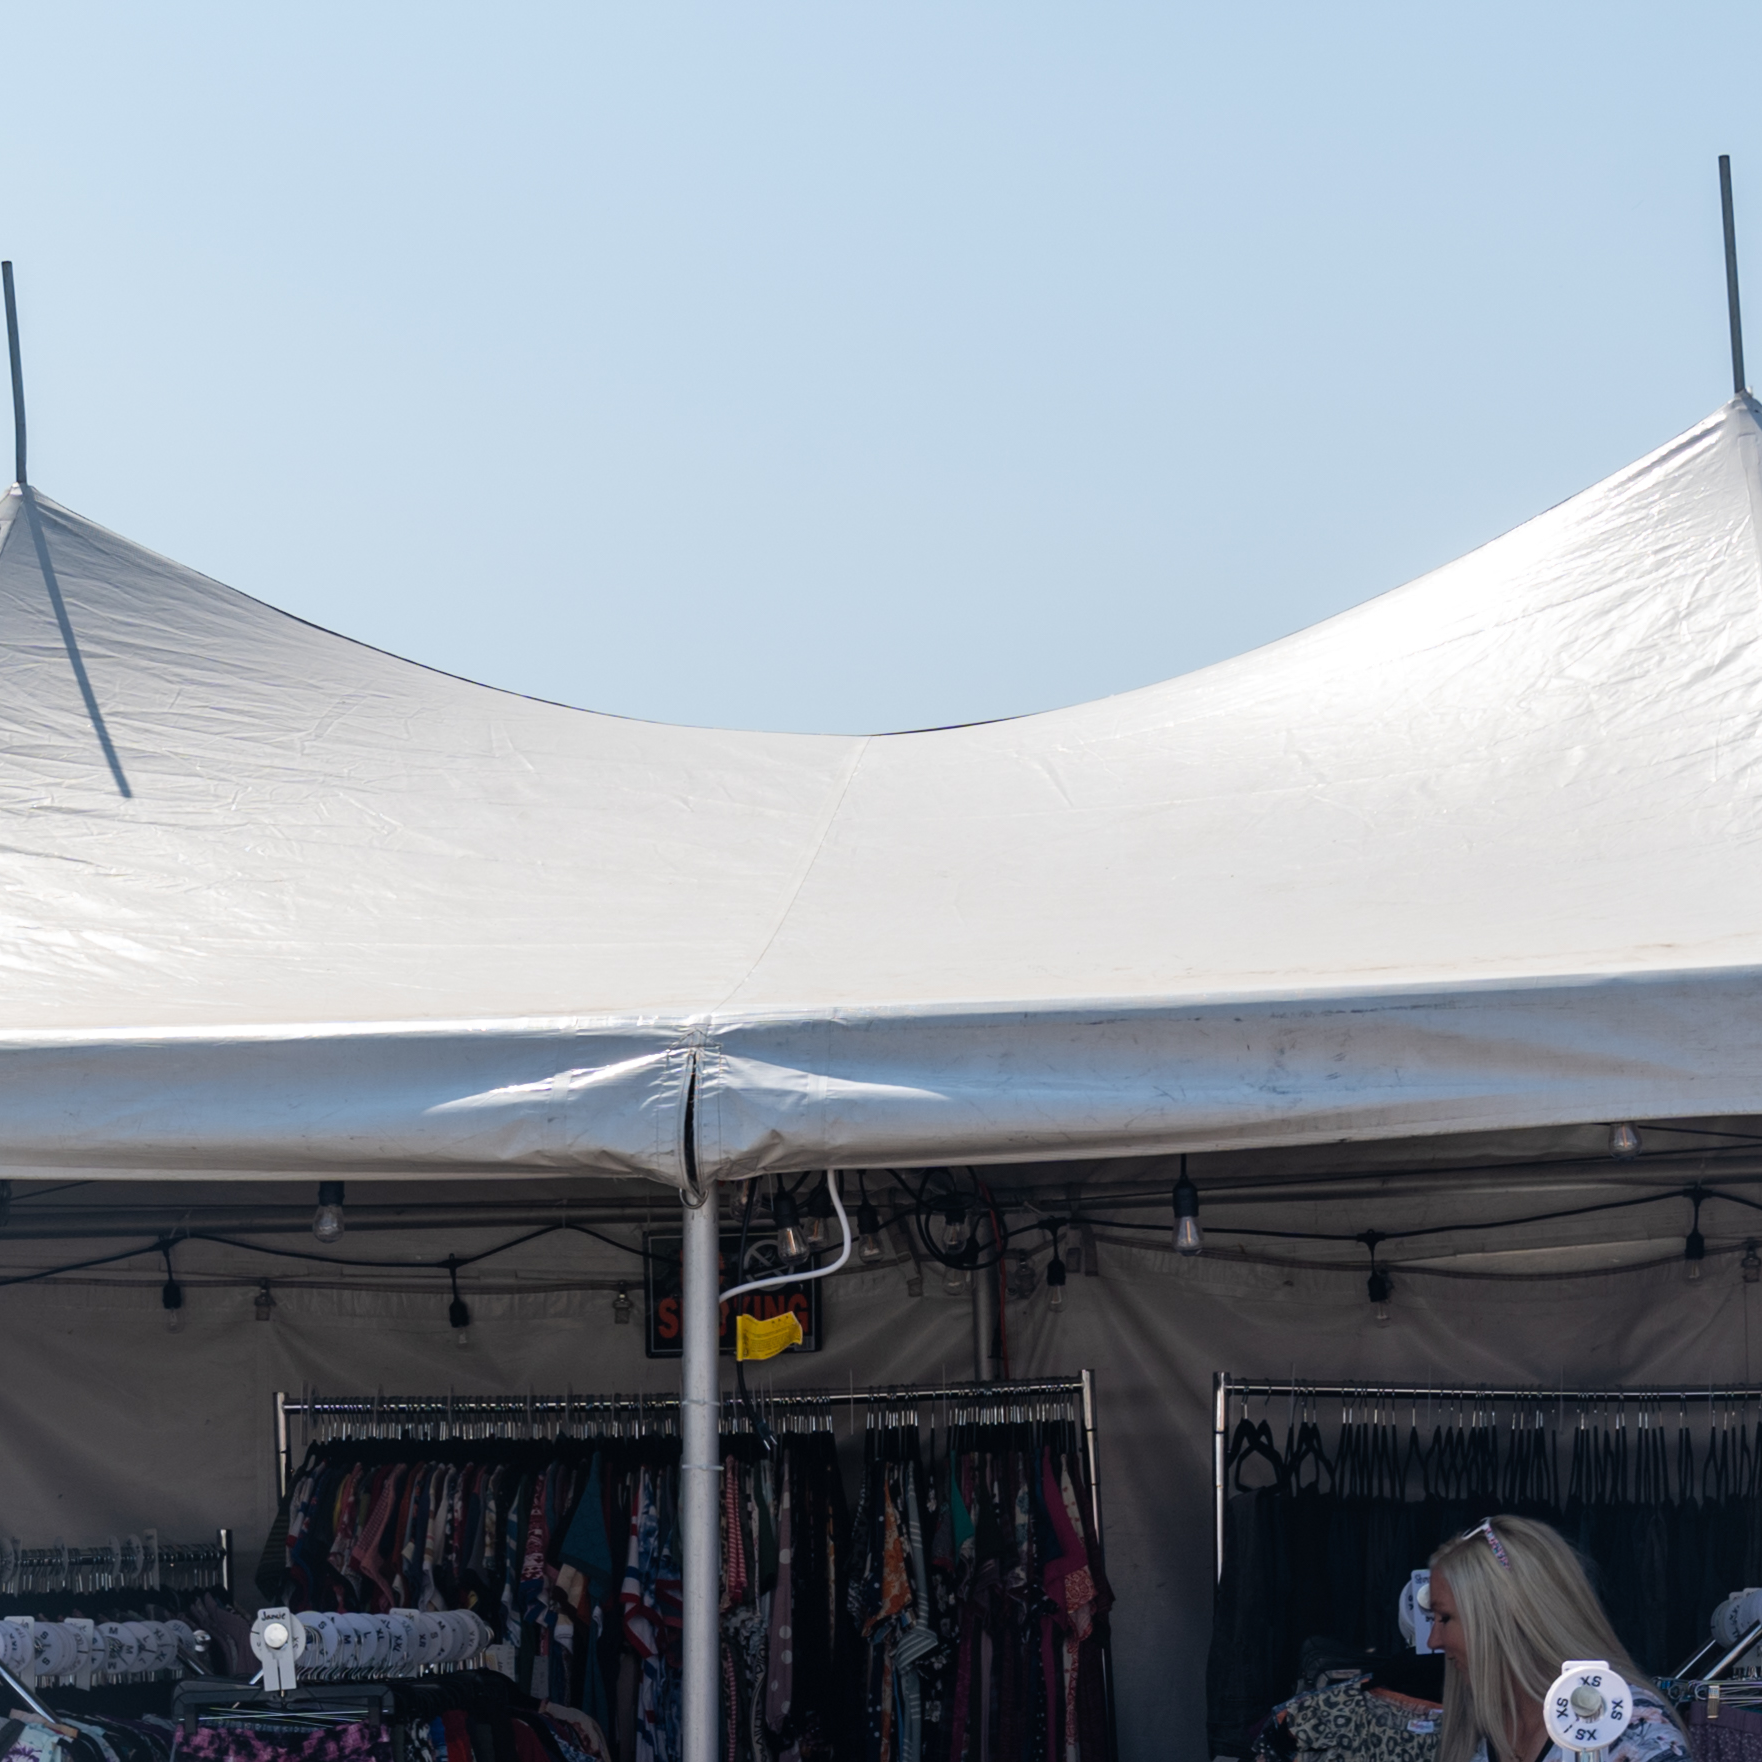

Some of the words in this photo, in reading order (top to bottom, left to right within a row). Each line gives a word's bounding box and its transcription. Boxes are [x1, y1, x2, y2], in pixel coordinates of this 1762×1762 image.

[261, 1611, 286, 1621] Jamie
[40, 1630, 49, 1640] S
[108, 1626, 118, 1635] M
[1580, 1675, 1602, 1687] XS
[1556, 1697, 1569, 1719] XS
[1610, 1699, 1623, 1721] XS
[1575, 1728, 1597, 1741] XS
